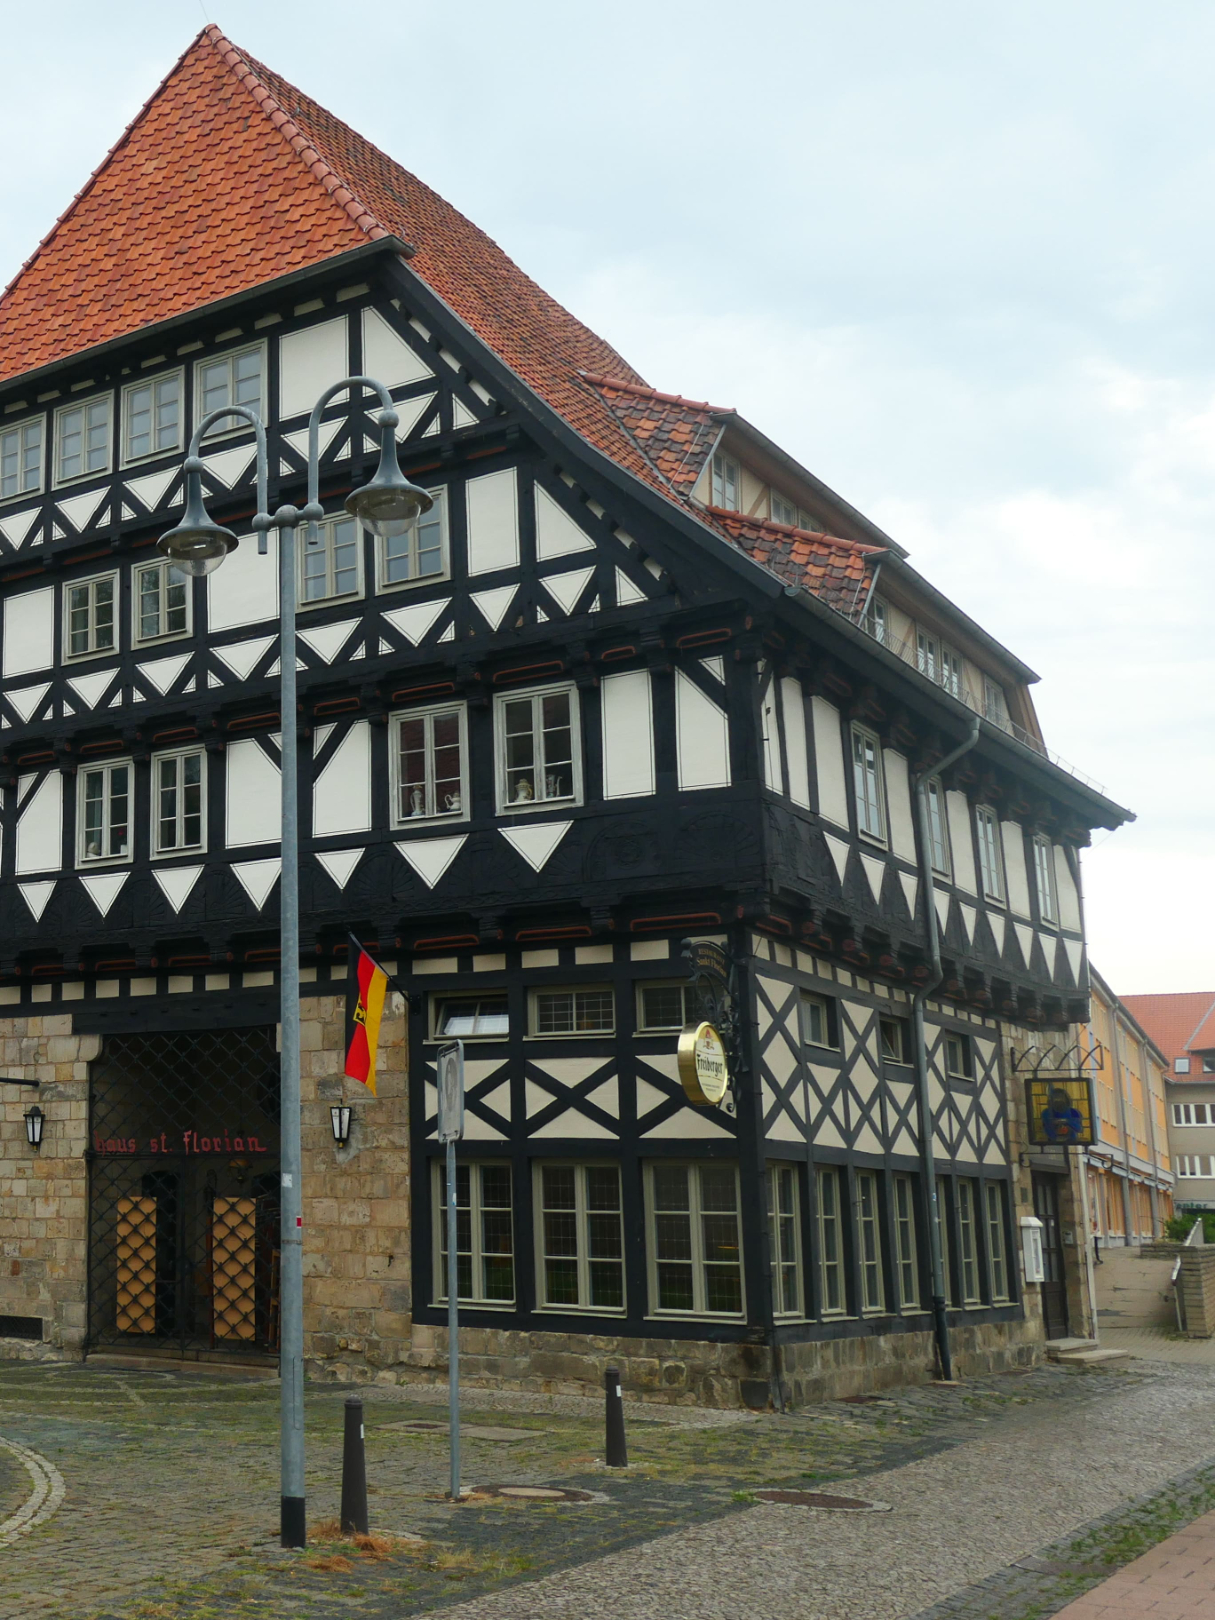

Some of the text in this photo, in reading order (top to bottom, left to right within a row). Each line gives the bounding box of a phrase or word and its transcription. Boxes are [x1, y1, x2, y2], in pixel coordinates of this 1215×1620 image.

[696, 1053, 723, 1077] Freiberger
[94, 1130, 136, 1157] haus
[150, 1132, 173, 1153] st.
